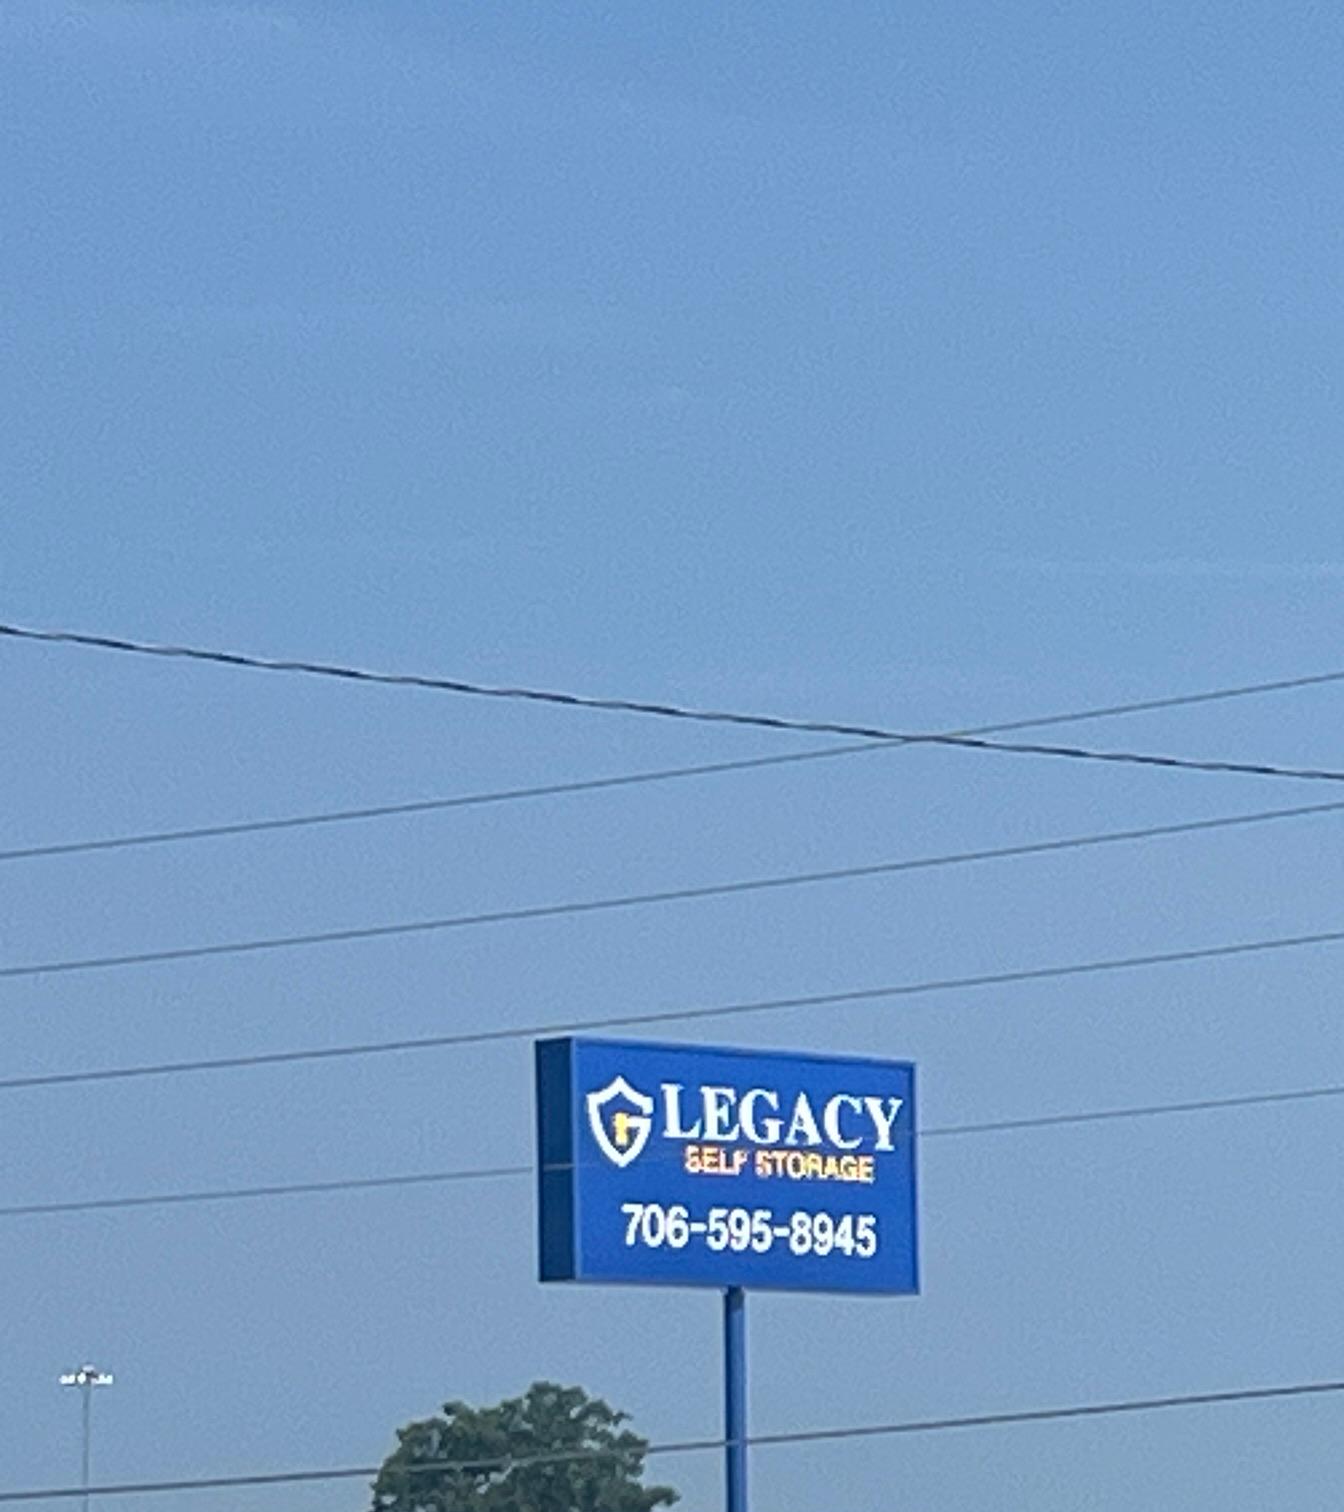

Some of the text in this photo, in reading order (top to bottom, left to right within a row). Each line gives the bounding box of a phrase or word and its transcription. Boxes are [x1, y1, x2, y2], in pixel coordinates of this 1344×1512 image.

[660, 1082, 904, 1152] LEGACY
[685, 1145, 876, 1184] SELF STORAGE
[621, 1203, 877, 1258] 706-595-8945
